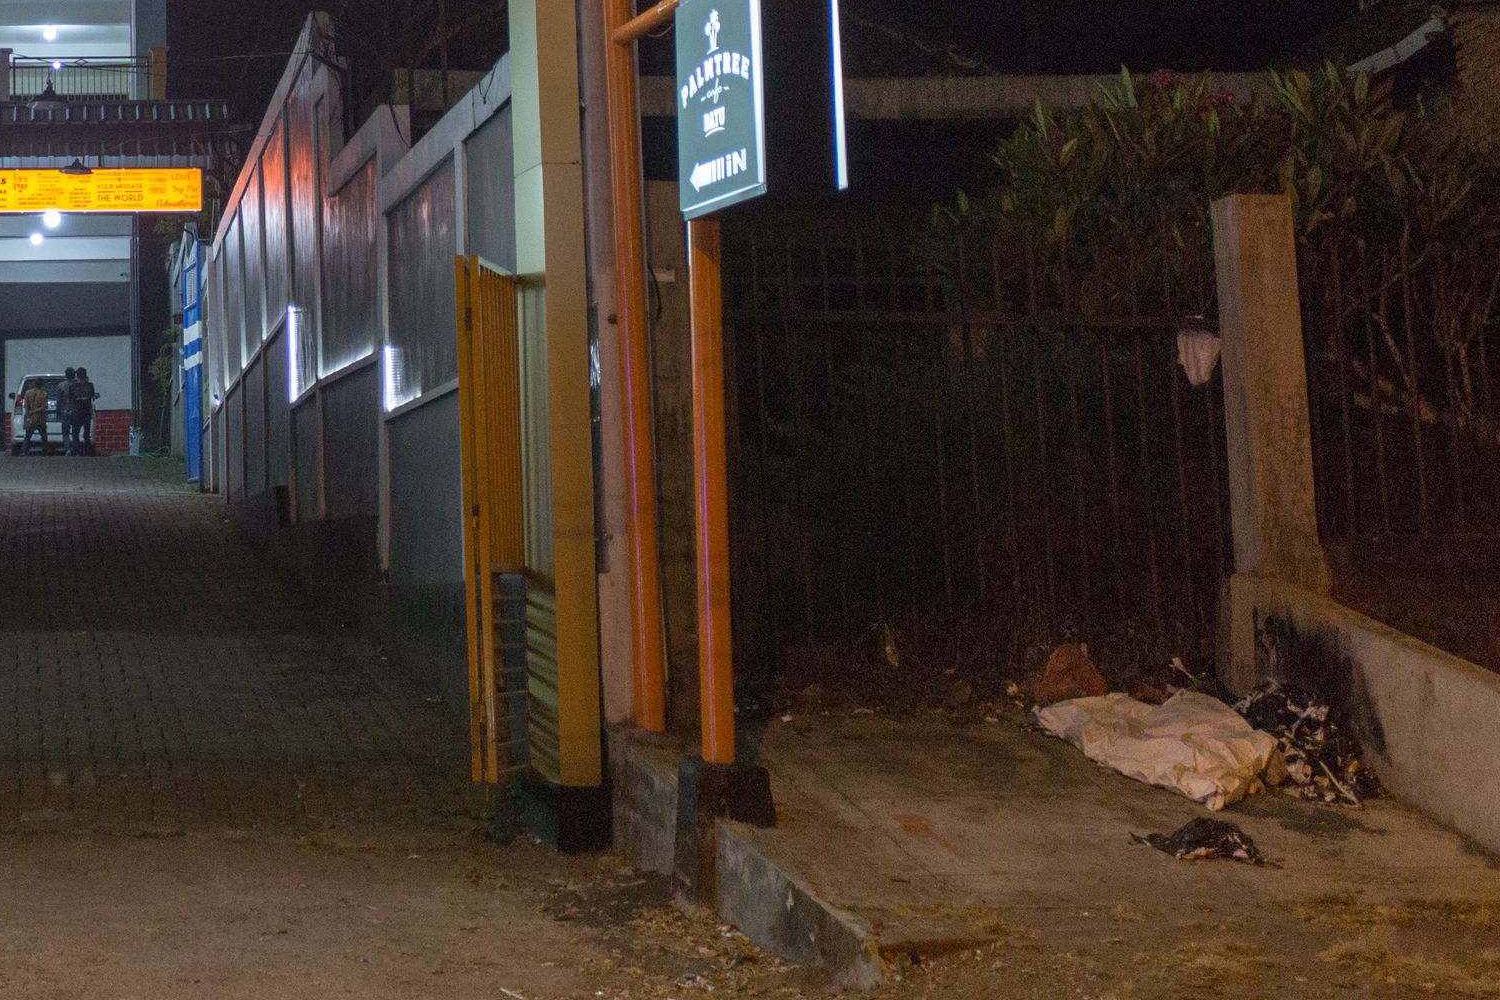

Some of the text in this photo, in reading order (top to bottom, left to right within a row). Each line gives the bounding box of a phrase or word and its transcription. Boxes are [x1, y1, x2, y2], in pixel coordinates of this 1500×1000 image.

[680, 51, 750, 109] PALMTREE
[703, 106, 726, 133] BATU
[113, 194, 144, 202] WORLD
